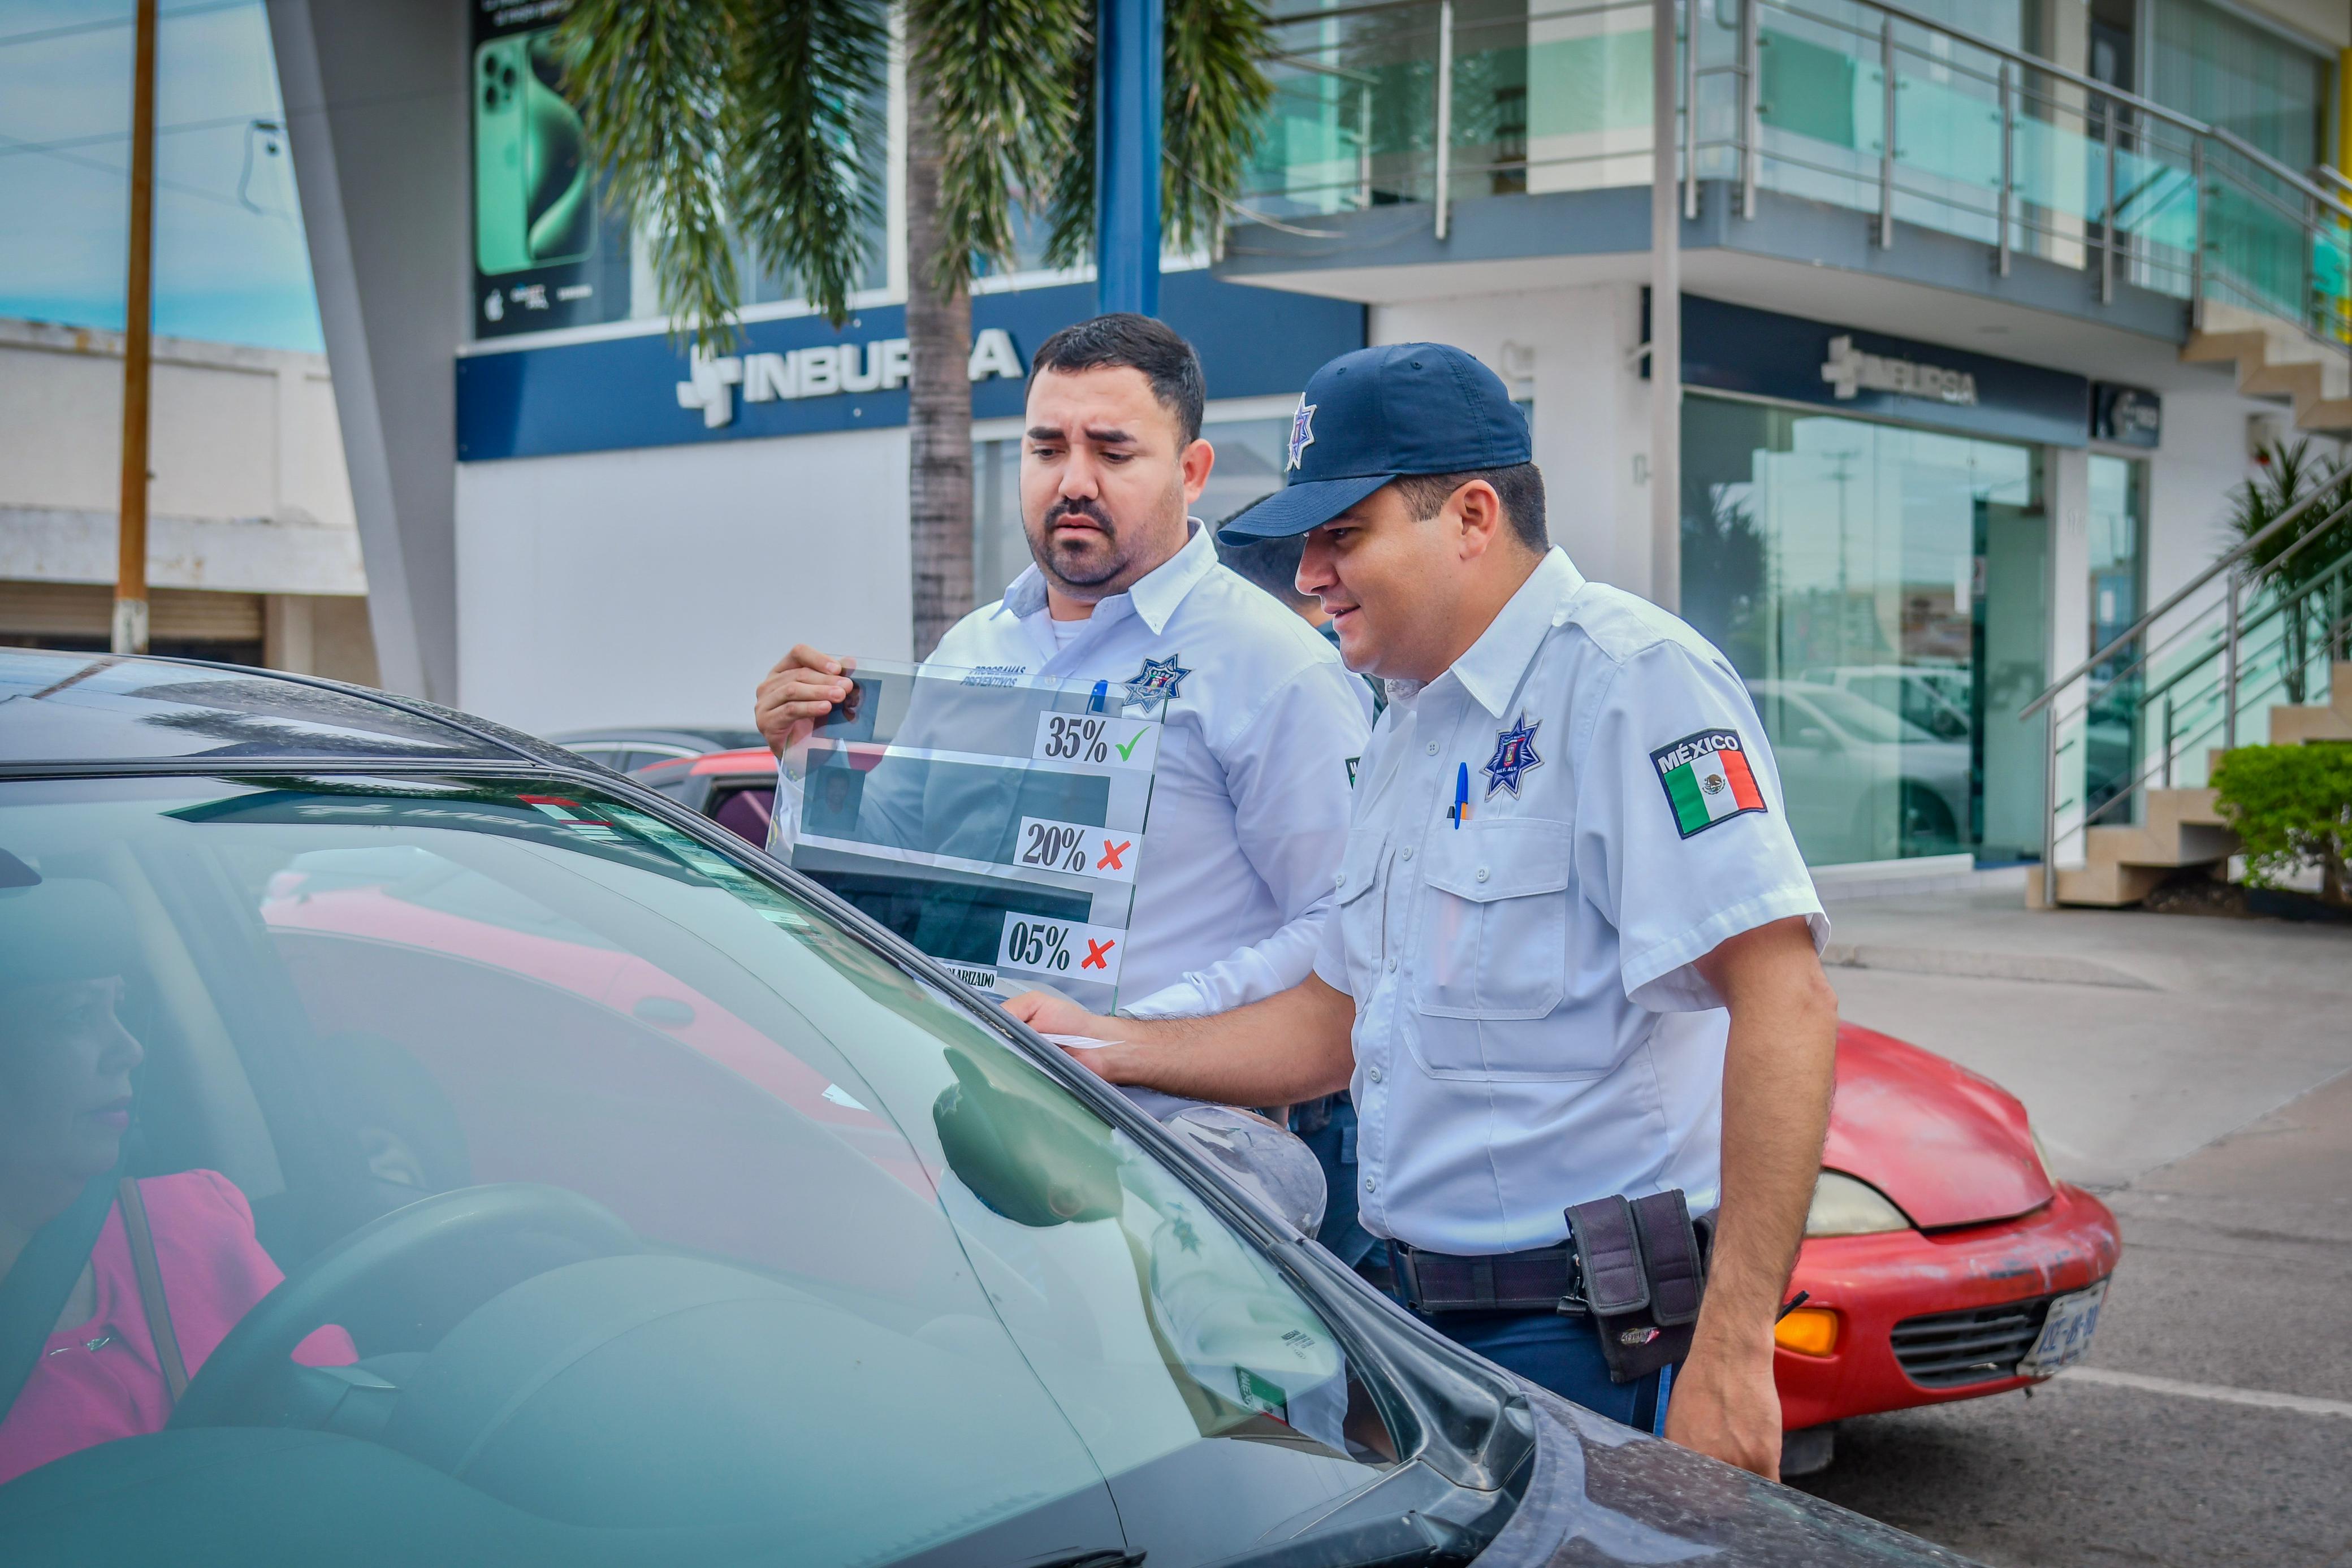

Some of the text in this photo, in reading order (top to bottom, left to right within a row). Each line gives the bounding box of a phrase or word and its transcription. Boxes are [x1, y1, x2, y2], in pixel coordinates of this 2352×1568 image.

[742, 328, 1022, 402] INBURA
[1045, 716, 1108, 763] 35%
[1657, 734, 1739, 774] MÉXICO
[1022, 823, 1086, 872] 20%
[1009, 921, 1070, 971] 05%
